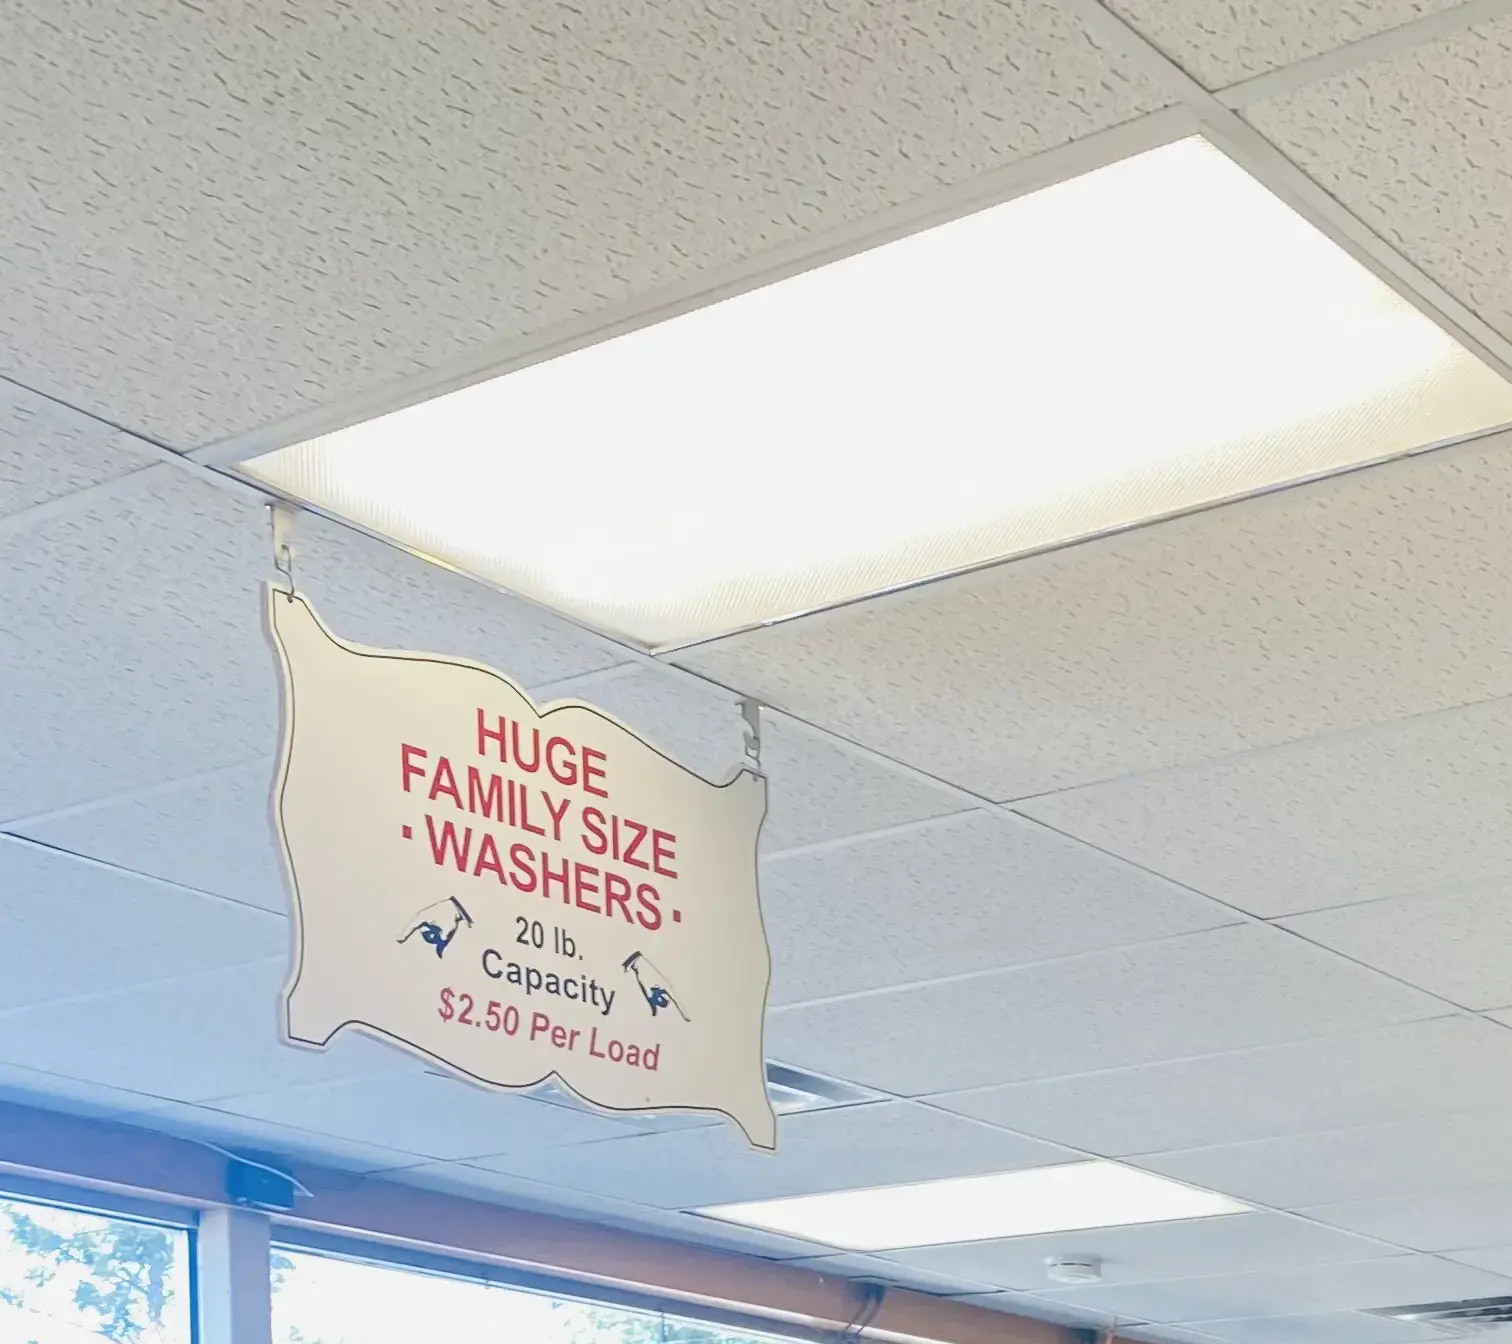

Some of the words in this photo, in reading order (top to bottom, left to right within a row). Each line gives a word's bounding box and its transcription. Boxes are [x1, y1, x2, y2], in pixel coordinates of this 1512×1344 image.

[477, 708, 609, 798] HUGE
[402, 743, 571, 841] FAMILY
[581, 806, 678, 879] SIZE
[424, 814, 661, 931] WASHERS
[516, 916, 544, 949] 20
[554, 927, 583, 960] lb.
[482, 949, 615, 1015] Capacity
[438, 987, 519, 1036] $2.50
[530, 1012, 580, 1050] Per
[589, 1027, 660, 1071] Load
